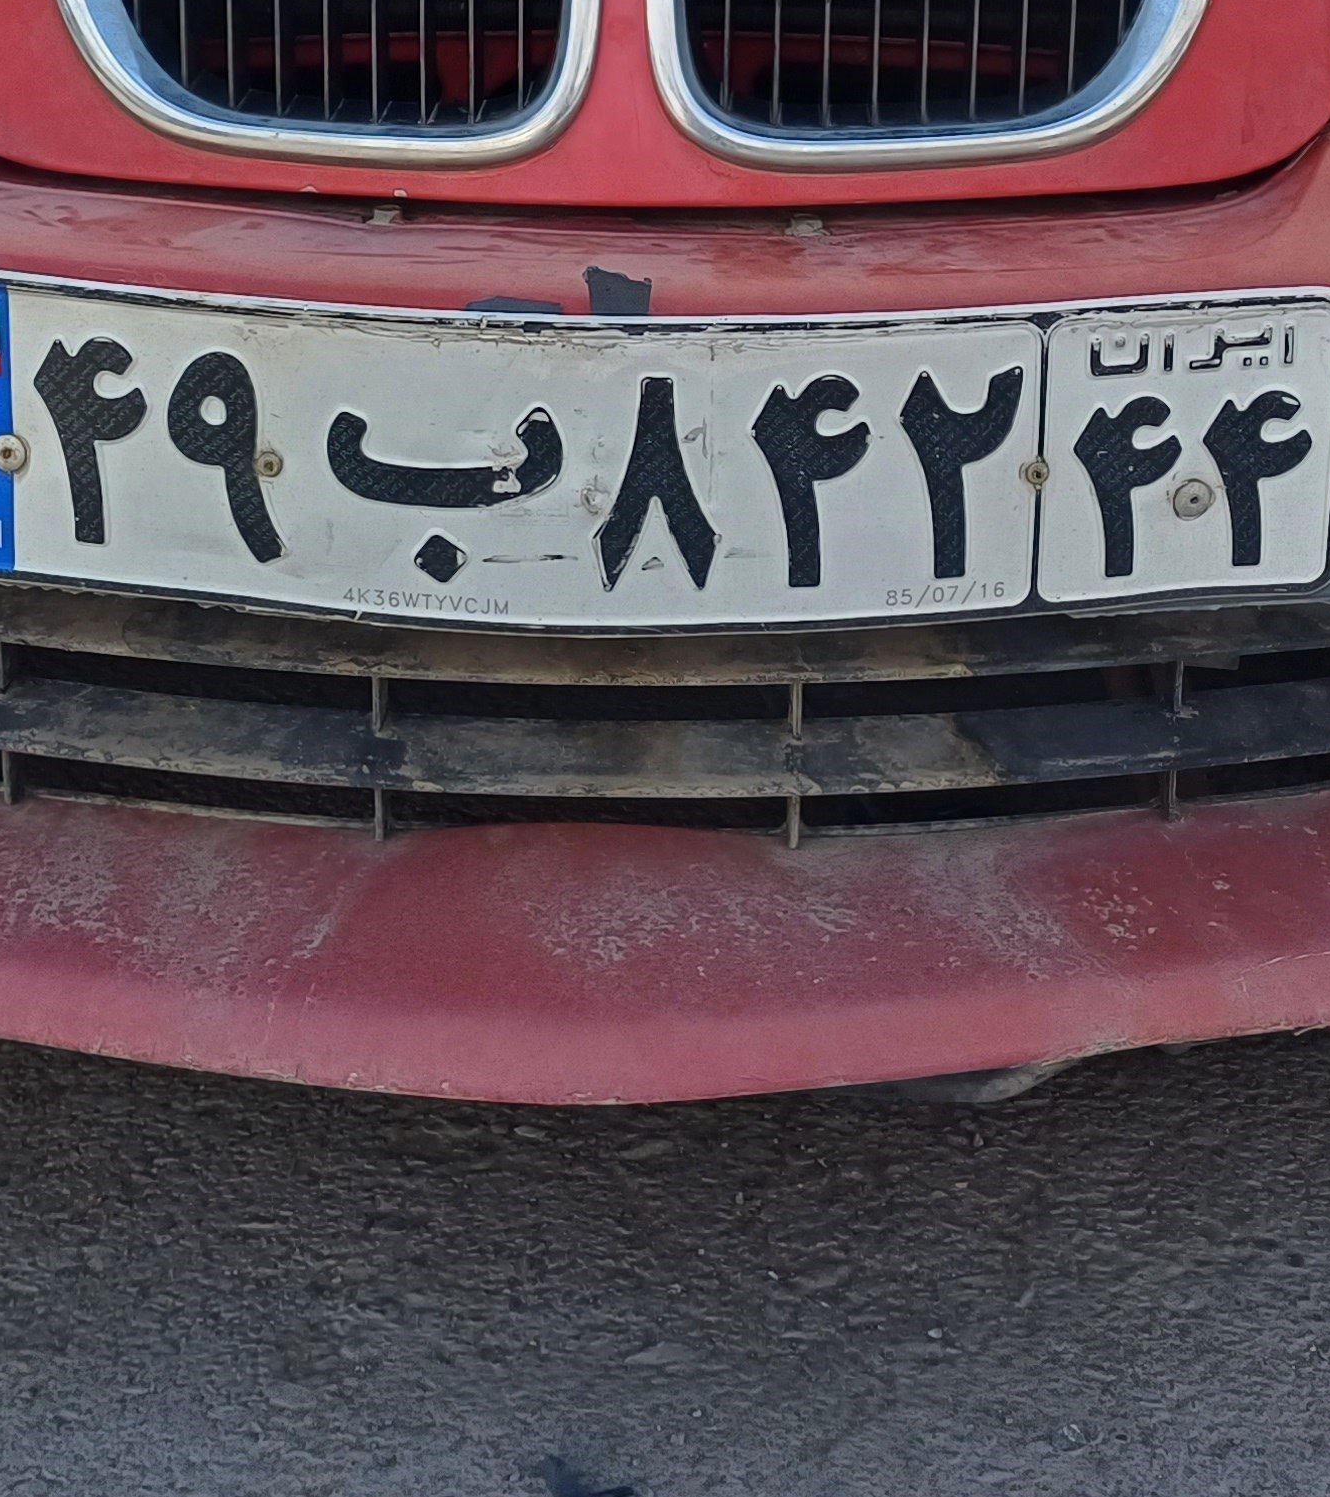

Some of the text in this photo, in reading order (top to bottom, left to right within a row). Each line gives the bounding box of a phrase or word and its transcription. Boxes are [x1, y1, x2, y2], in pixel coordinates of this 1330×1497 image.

[1089, 322, 1295, 377] ایران
[1073, 390, 1313, 578] ۴۴
[342, 587, 510, 615] 4K36WTYVCJM
[885, 580, 1005, 609] 85/07/16
